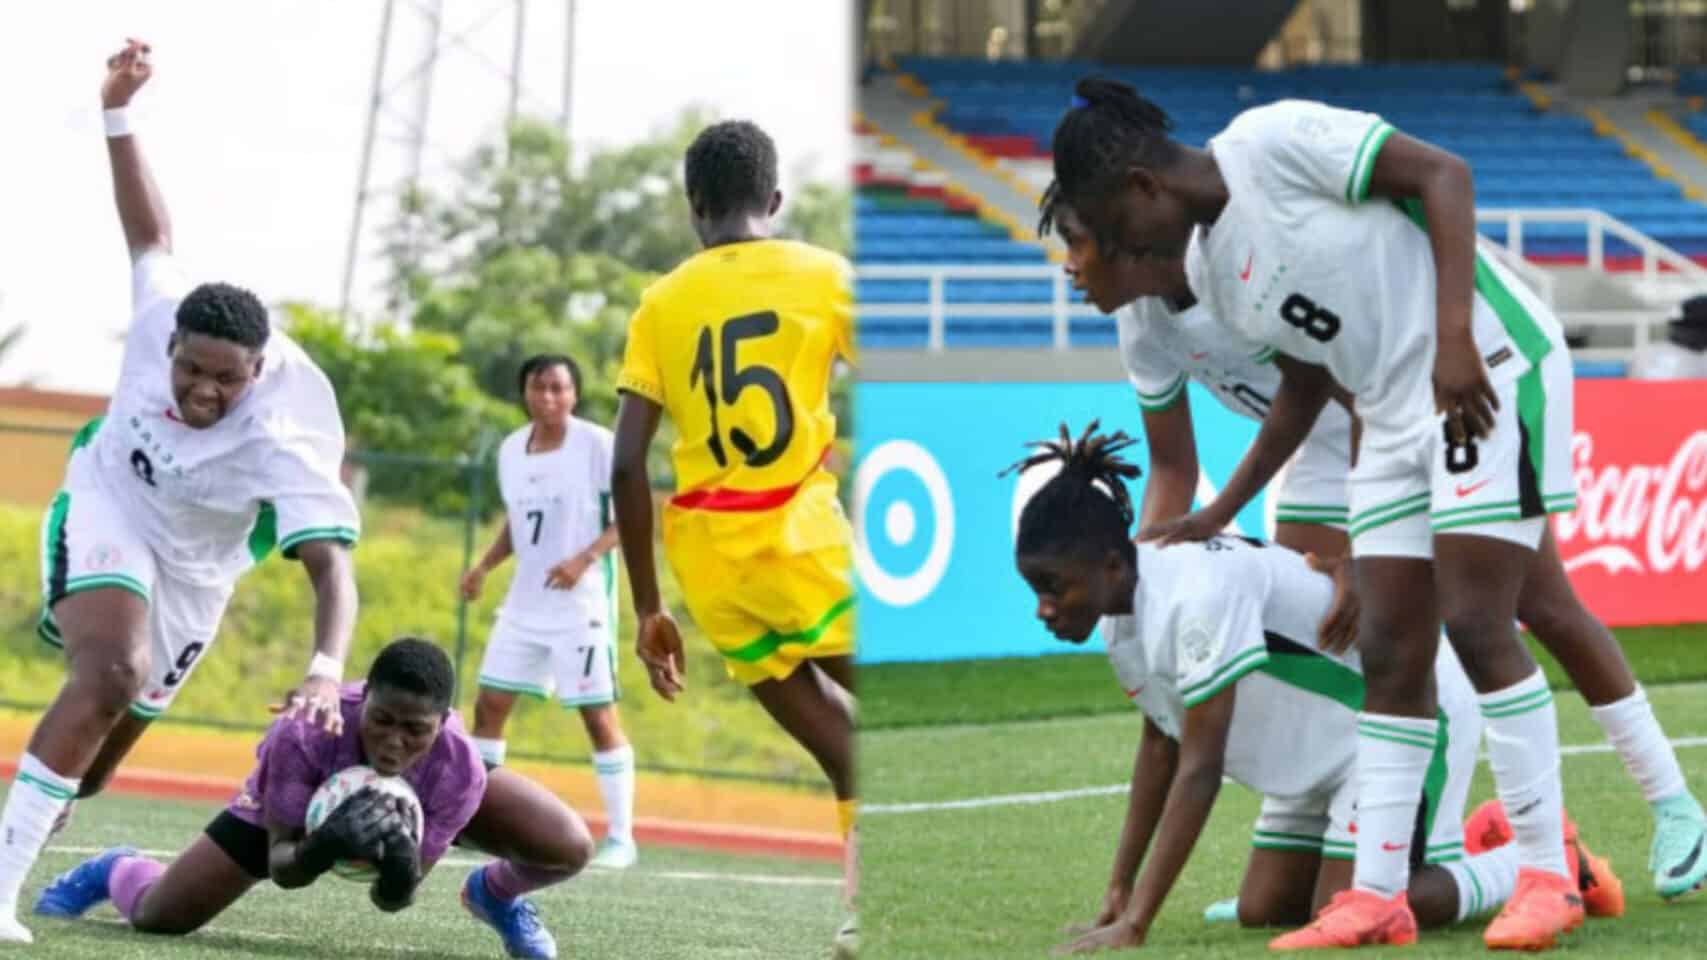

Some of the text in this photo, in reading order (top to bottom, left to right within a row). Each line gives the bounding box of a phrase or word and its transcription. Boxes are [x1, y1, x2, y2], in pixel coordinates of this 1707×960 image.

[1280, 293, 1341, 343] 8
[690, 310, 795, 468] 15
[527, 510, 544, 545] 7
[164, 641, 204, 687] 9
[577, 645, 595, 677] 7
